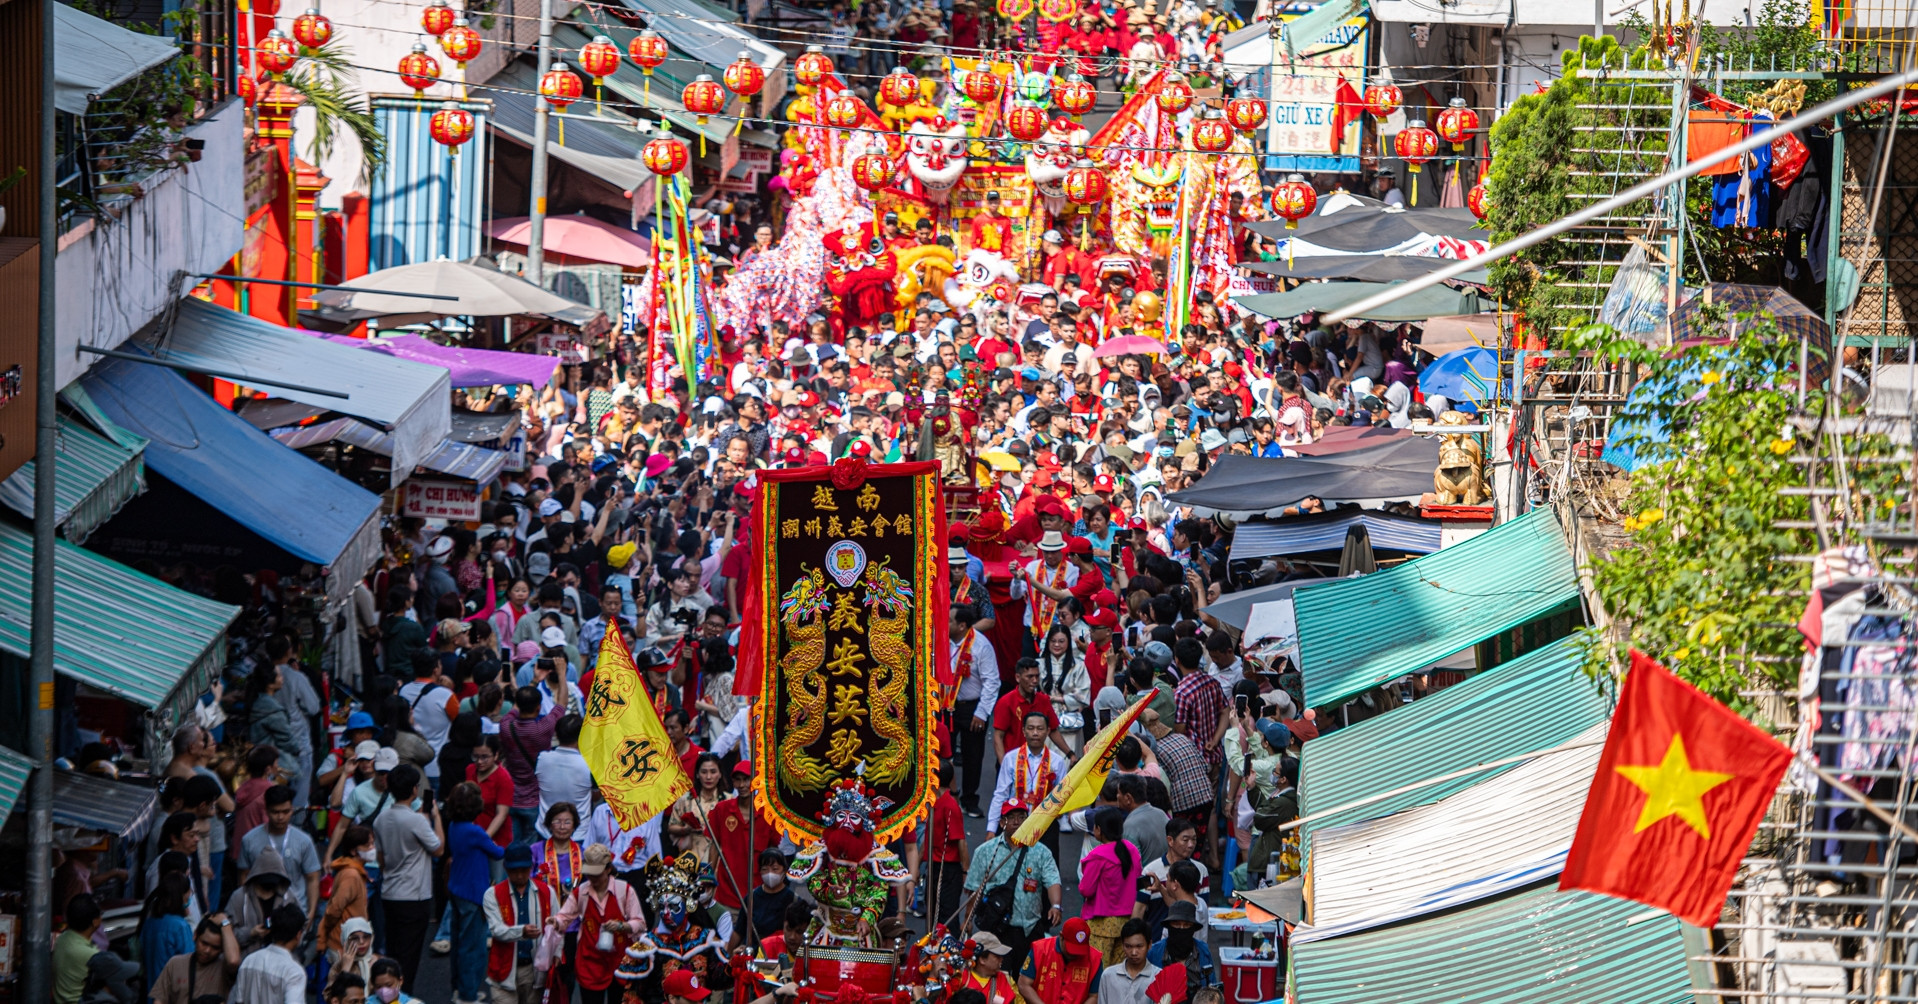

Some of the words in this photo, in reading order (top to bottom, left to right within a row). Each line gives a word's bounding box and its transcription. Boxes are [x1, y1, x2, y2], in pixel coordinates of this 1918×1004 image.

[1304, 107, 1323, 125] XE
[811, 483, 881, 512] 越南
[781, 513, 913, 539] 潮州義安會館
[826, 591, 868, 770] 義安英歌
